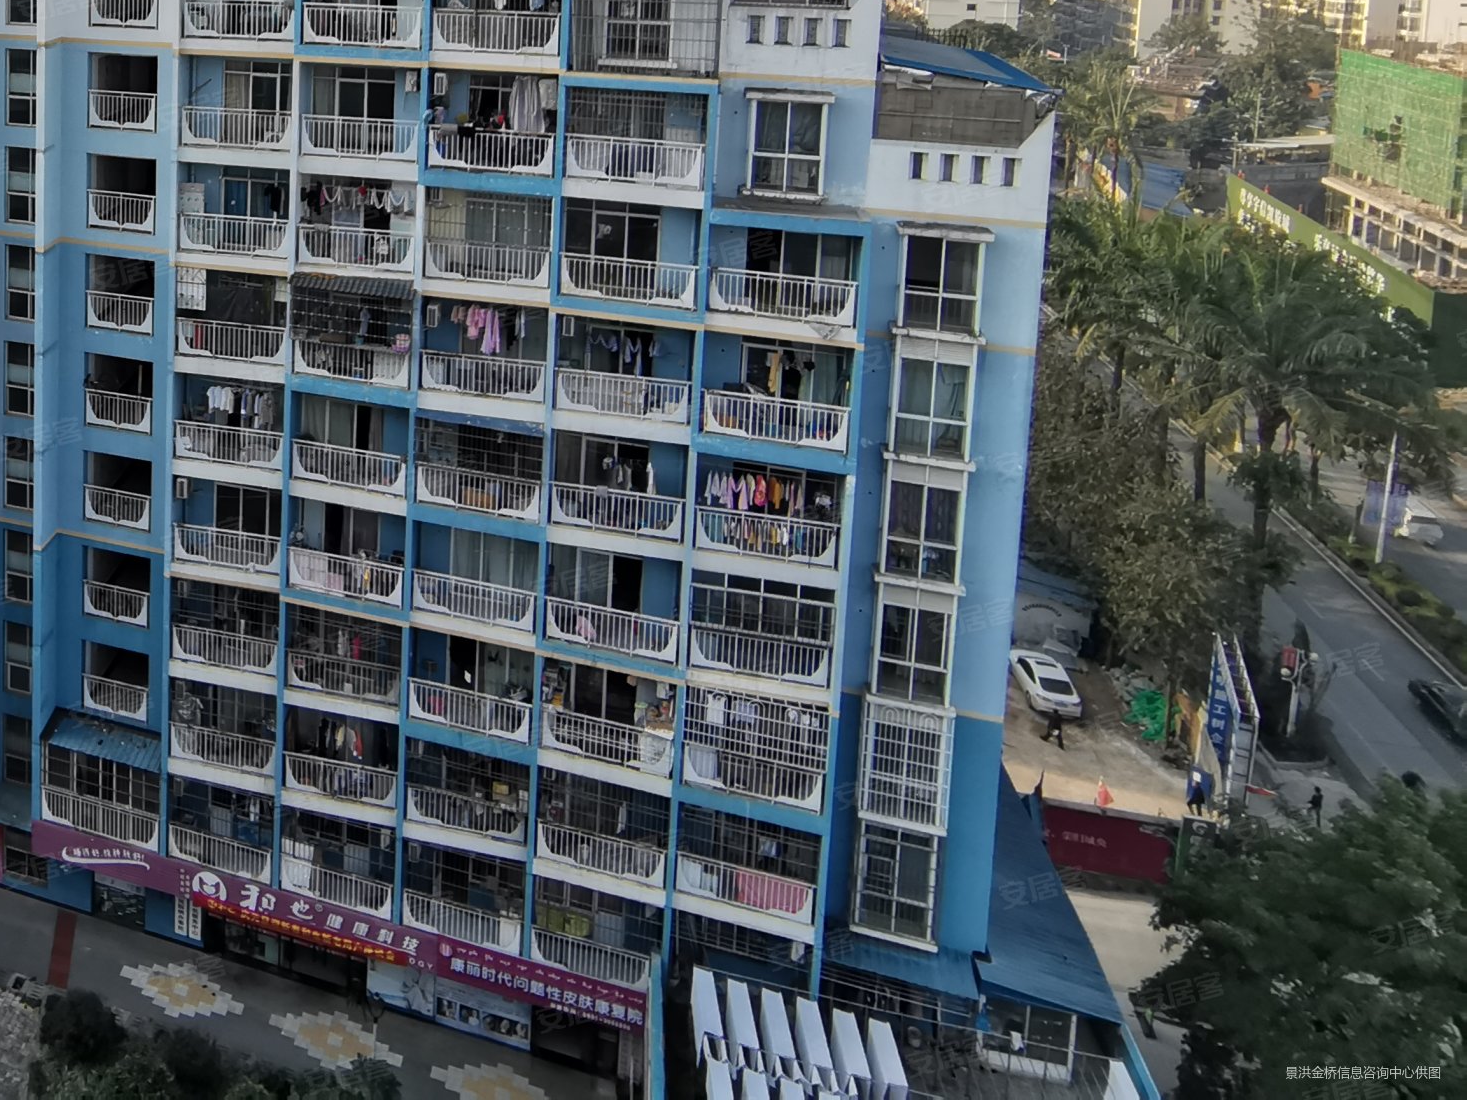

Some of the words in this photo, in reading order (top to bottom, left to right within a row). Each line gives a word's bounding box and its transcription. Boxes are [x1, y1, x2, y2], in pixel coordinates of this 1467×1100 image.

[326, 913, 421, 954] 健康科技
[450, 956, 644, 1026] 康丽时代问题性皮肤康复院
